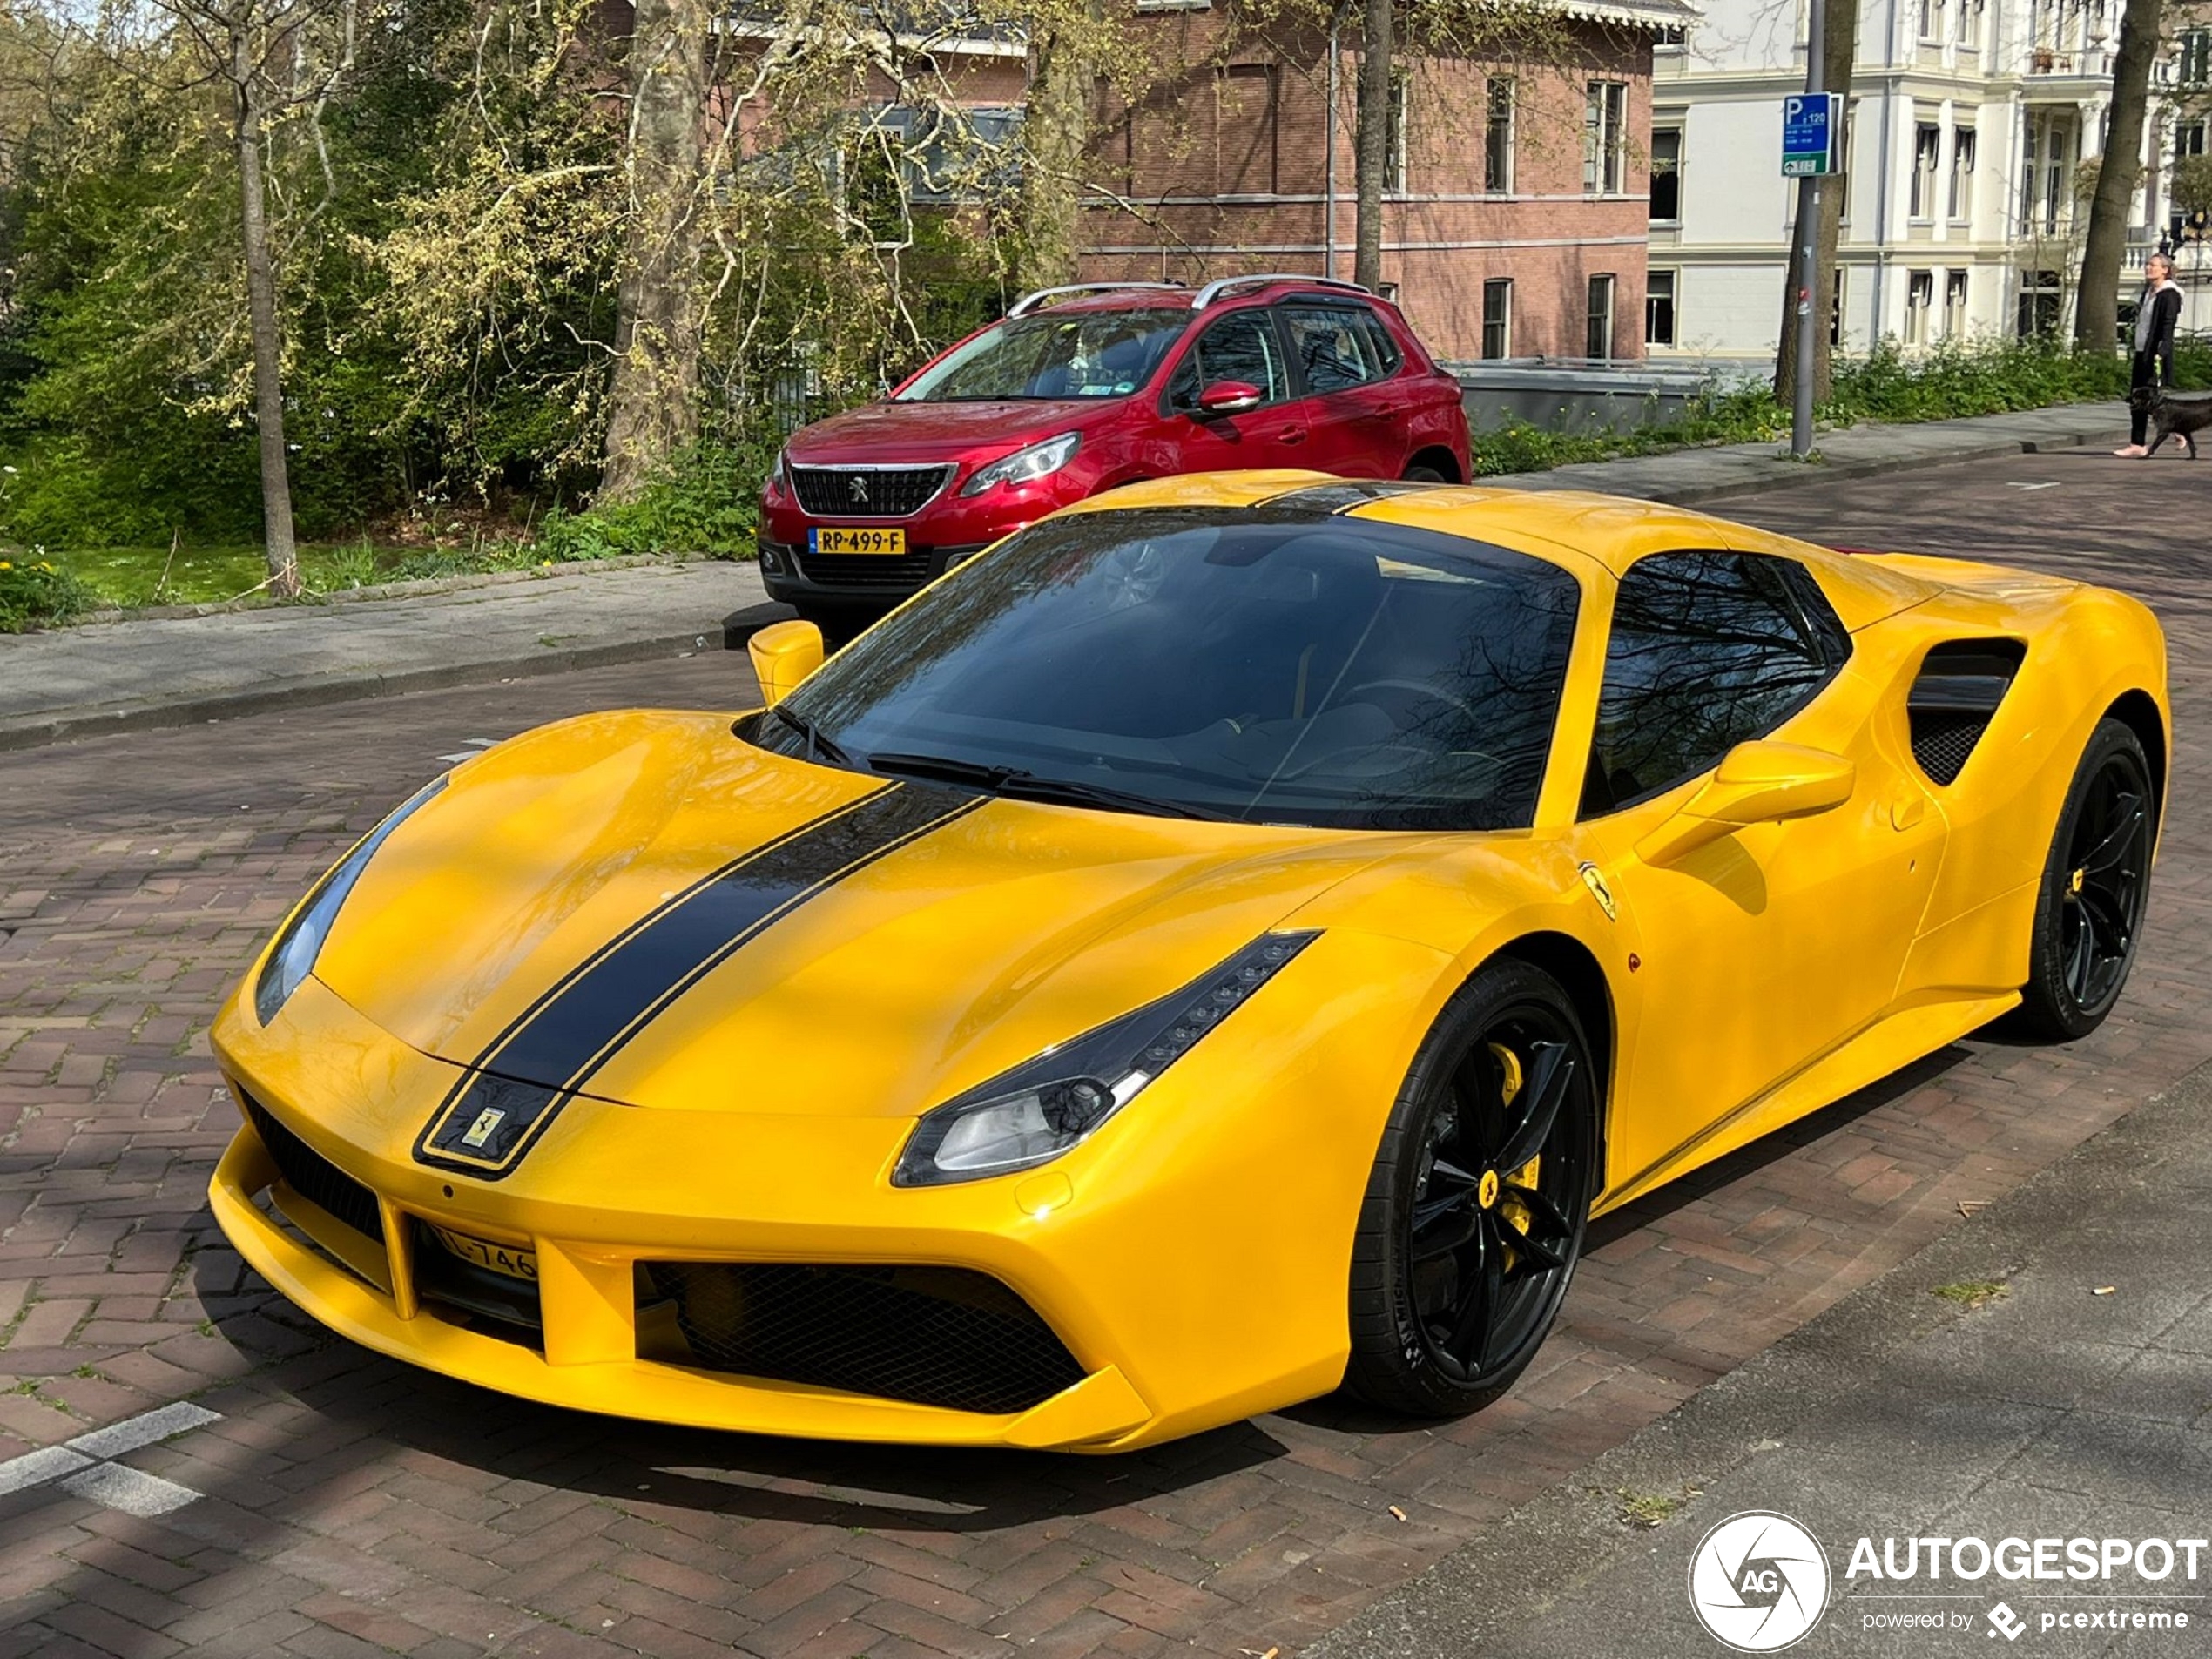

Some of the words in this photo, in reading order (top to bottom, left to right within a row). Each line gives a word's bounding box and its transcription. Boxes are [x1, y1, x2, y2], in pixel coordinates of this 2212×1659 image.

[1786, 98, 1803, 125] P
[1809, 112, 1826, 123] 120
[822, 531, 899, 551] RP-499-F
